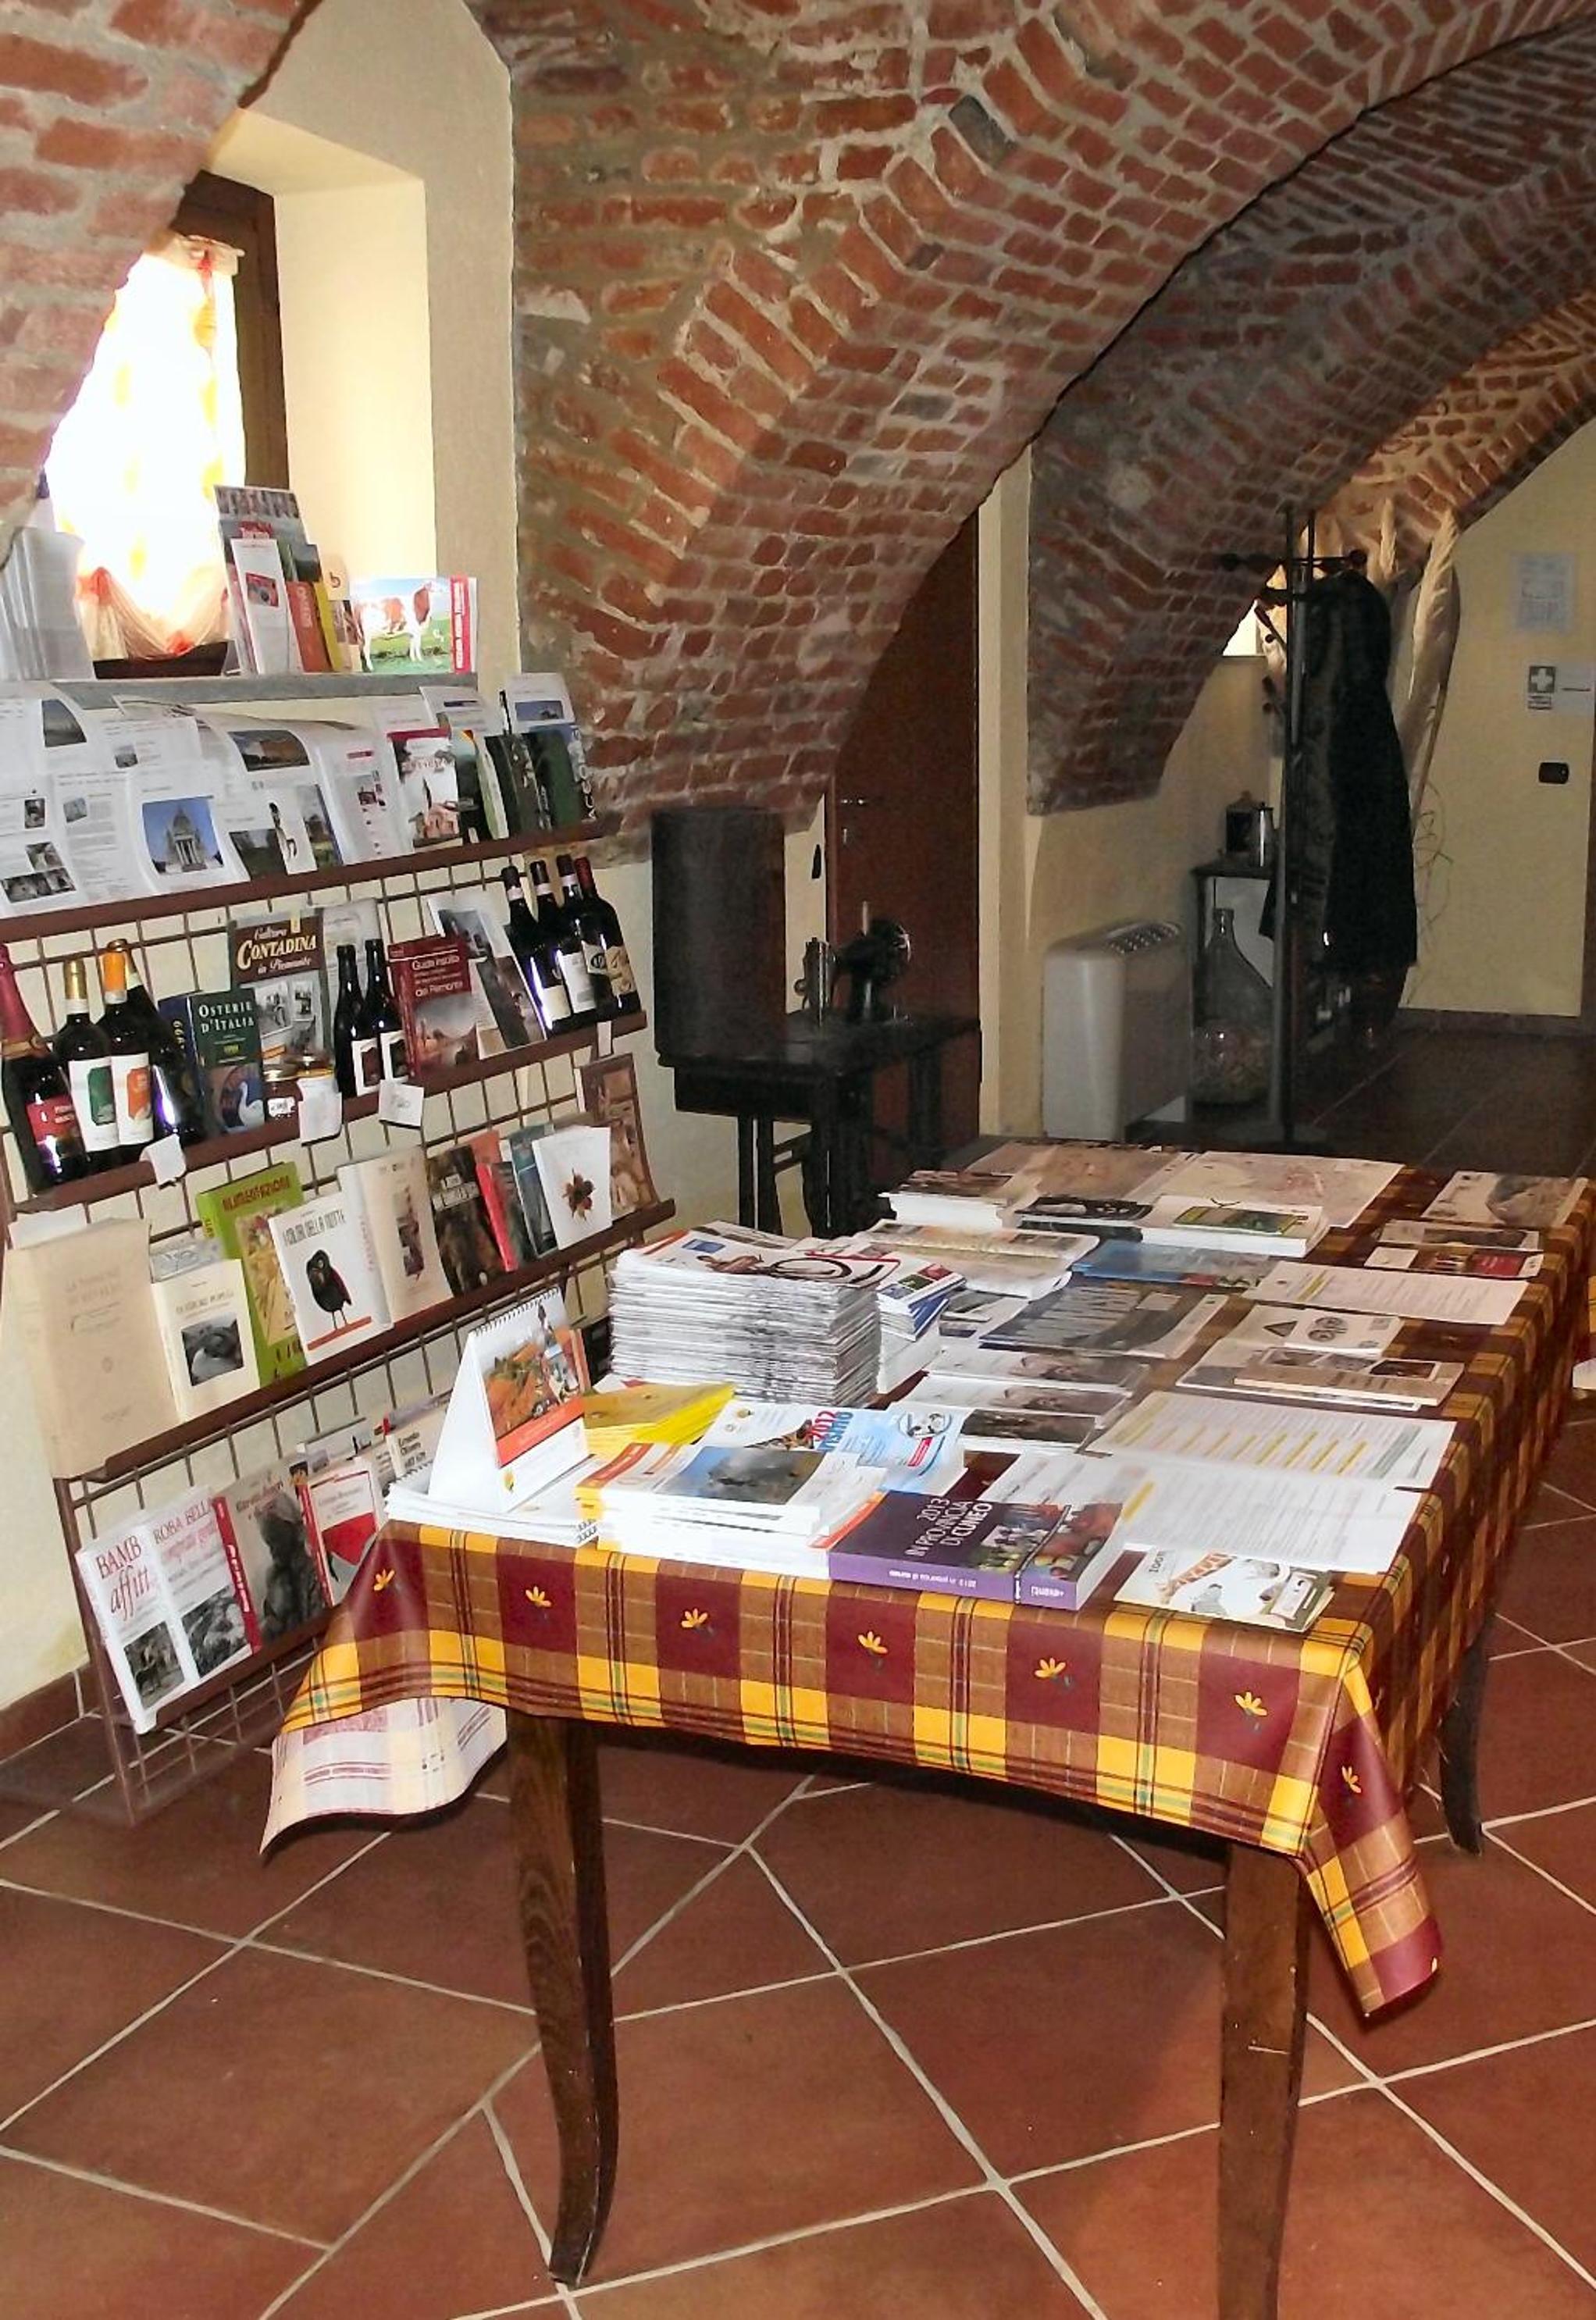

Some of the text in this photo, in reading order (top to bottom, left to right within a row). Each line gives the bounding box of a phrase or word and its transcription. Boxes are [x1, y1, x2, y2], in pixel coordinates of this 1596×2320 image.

[237, 935, 317, 970] CONTADINA
[915, 1499, 974, 1550] PROVINCIA
[917, 1497, 951, 1522] 2013
[939, 1502, 994, 1546] DI CUNEO
